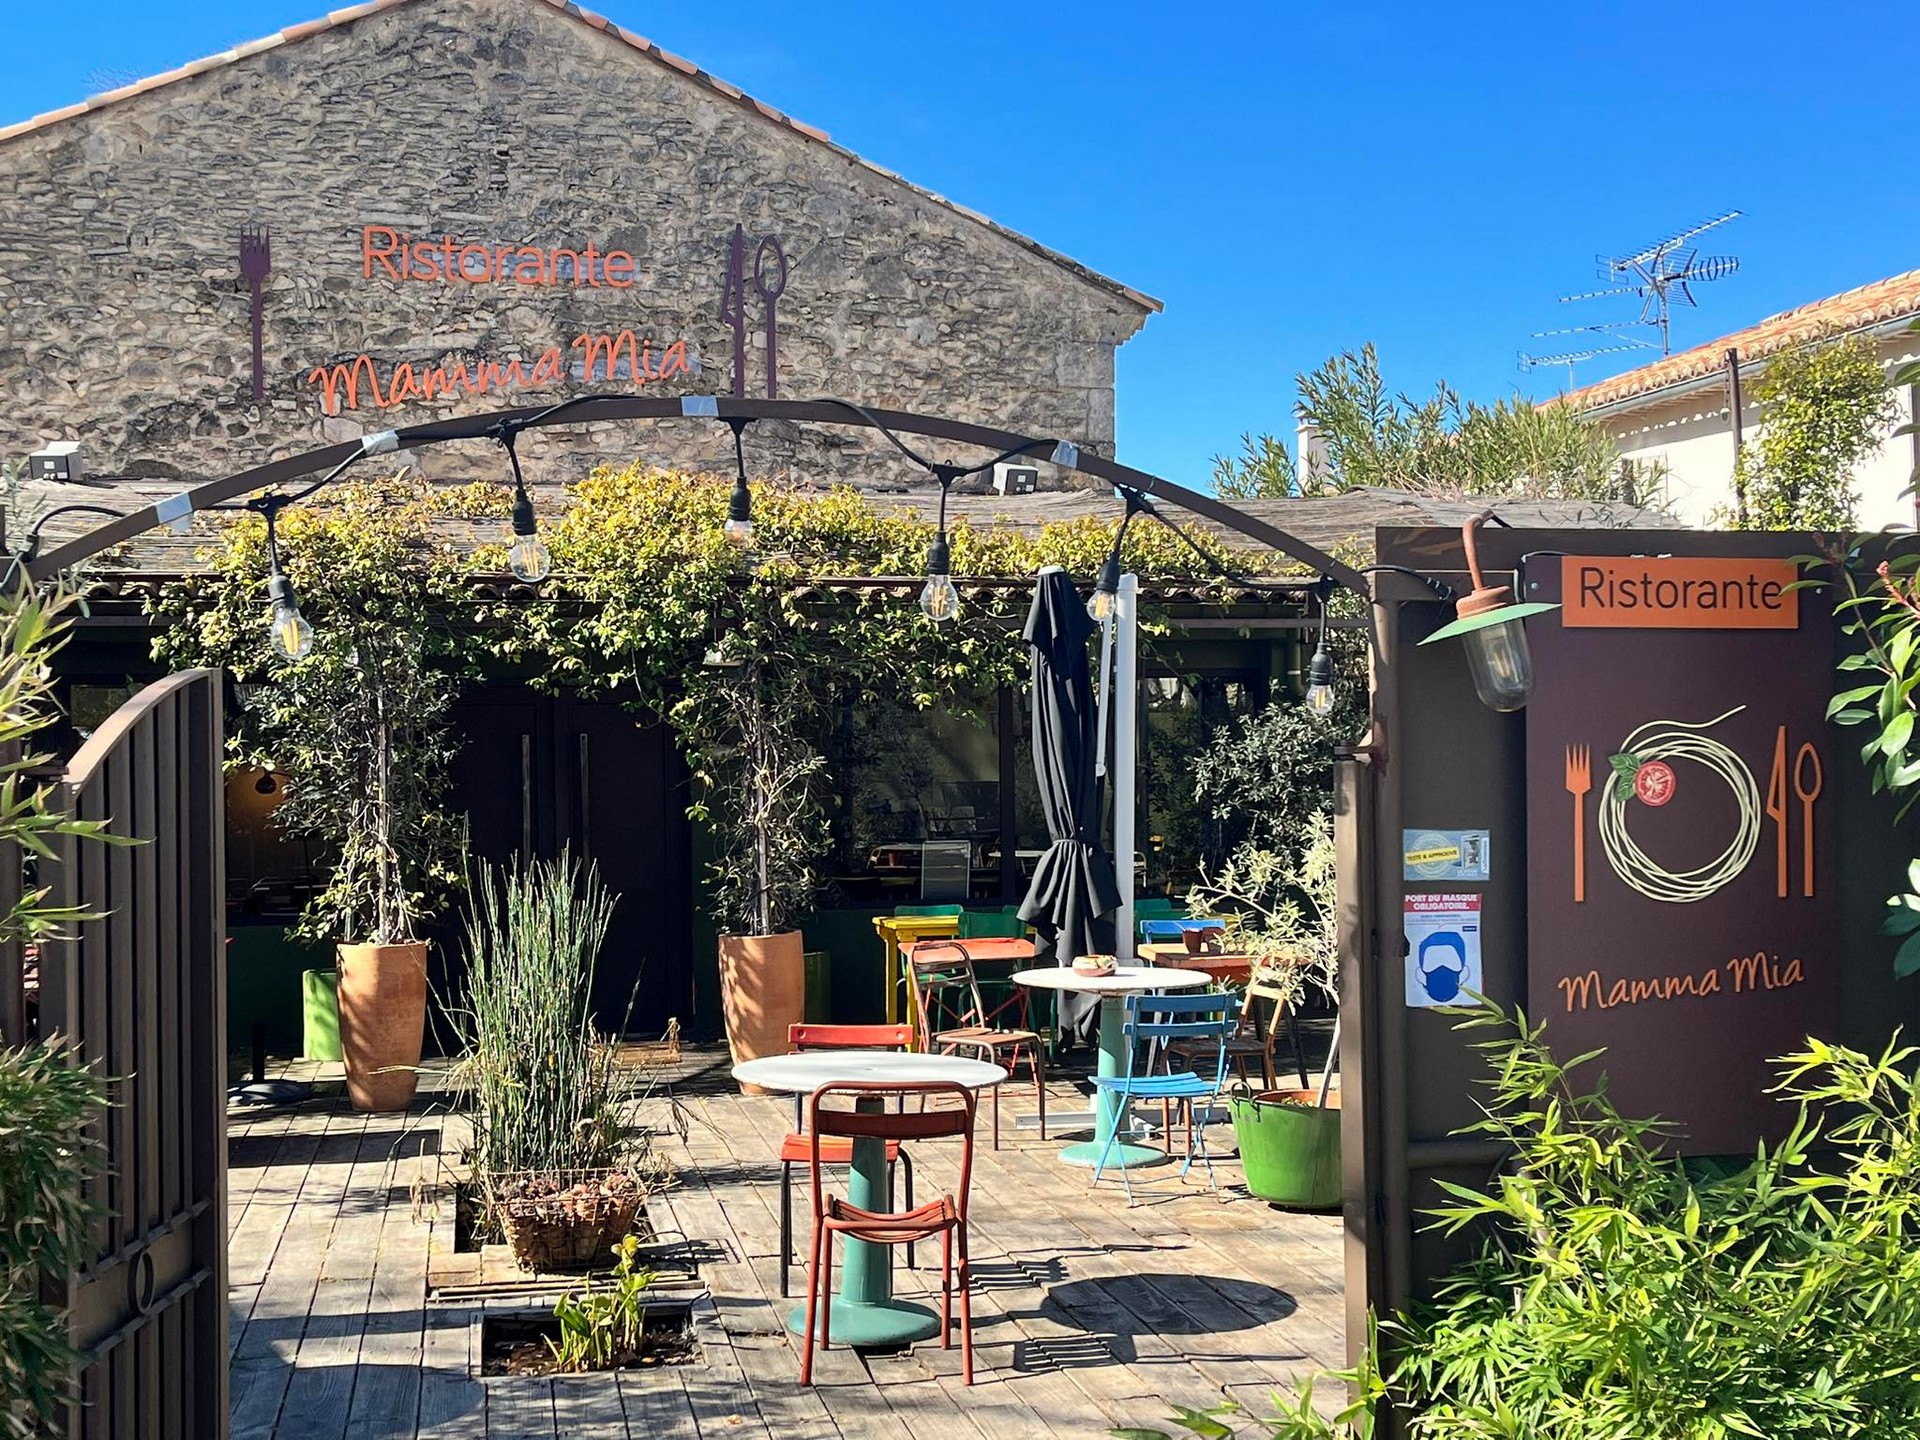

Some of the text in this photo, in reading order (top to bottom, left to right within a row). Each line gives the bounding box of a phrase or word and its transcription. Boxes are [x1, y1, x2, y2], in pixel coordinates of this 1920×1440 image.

[362, 225, 635, 288] Ristorante
[308, 329, 692, 416] Mamma Mia
[1580, 566, 1783, 610] Ristorante
[1405, 894, 1427, 902] PORT
[1442, 894, 1478, 902] MASQUE
[1557, 951, 1804, 1012] Mamma Mia
